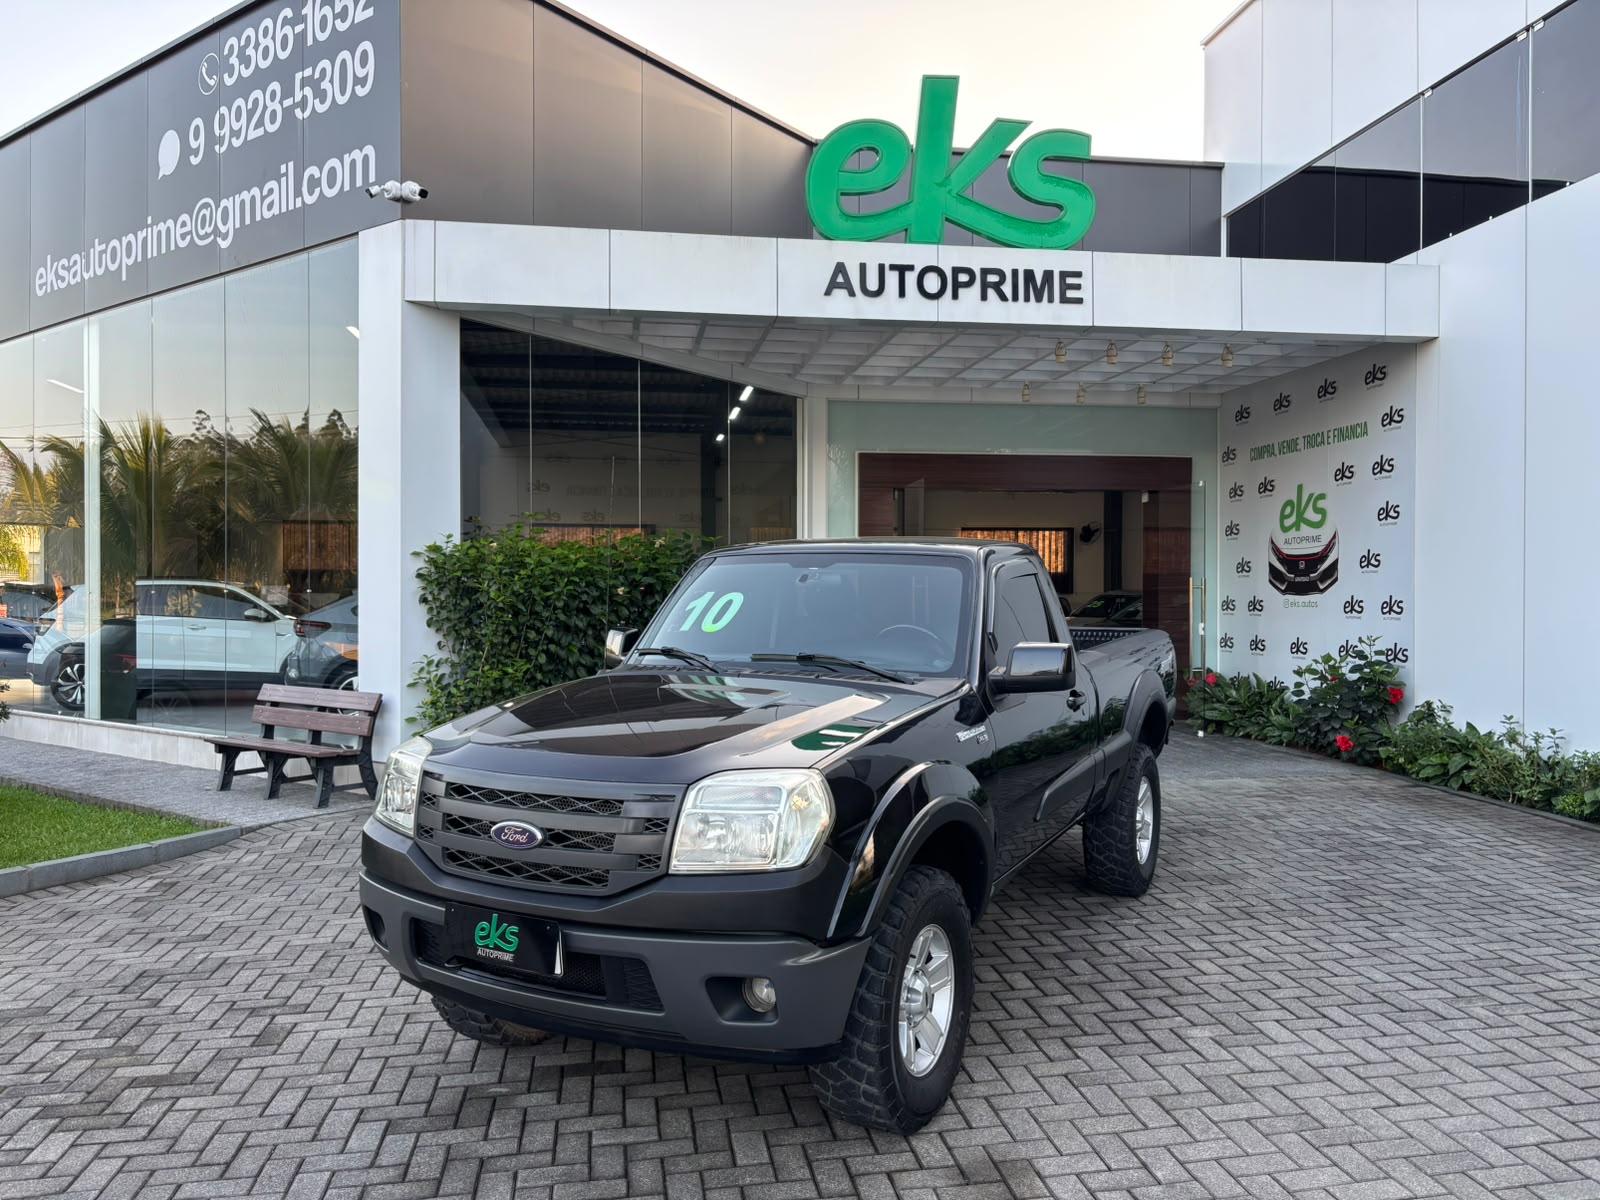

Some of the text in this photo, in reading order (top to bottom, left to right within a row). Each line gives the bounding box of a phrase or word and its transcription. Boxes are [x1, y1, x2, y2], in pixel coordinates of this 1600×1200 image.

[188, 40, 375, 165] 9 9928-5309
[805, 74, 1097, 250] eks
[35, 144, 376, 297] eksautoprime@gmail.com
[823, 261, 1084, 305] AUTOPRIME
[1364, 363, 1387, 386] eks
[1317, 378, 1337, 399] eks
[1273, 392, 1291, 412] eks
[1234, 404, 1251, 423] eks
[1381, 405, 1405, 428] eks
[1249, 421, 1369, 462] COMPRA, VENDE, TROCA E FINANCIA
[1221, 446, 1237, 464] eks
[1371, 454, 1395, 476] eks
[1334, 462, 1355, 482] eks
[1228, 481, 1244, 499] eks
[1257, 476, 1275, 495] eks
[1279, 483, 1327, 533] eks
[1377, 500, 1400, 522] eks
[1224, 519, 1240, 537] eks
[1283, 535, 1323, 545] AUTOPRIME
[1235, 557, 1252, 574] eks
[1359, 548, 1381, 569] eks
[680, 592, 744, 633] 10
[1221, 595, 1236, 612] eks
[1247, 595, 1264, 613] eks
[1343, 594, 1364, 615] eks
[1380, 594, 1404, 616] eks
[1219, 632, 1234, 649] eks
[1249, 634, 1266, 652] eks
[1290, 636, 1308, 656] eks
[1385, 642, 1409, 663] eks
[501, 826, 528, 843] Ford
[474, 913, 520, 952] eks
[476, 947, 515, 962] AUTOPRIME
